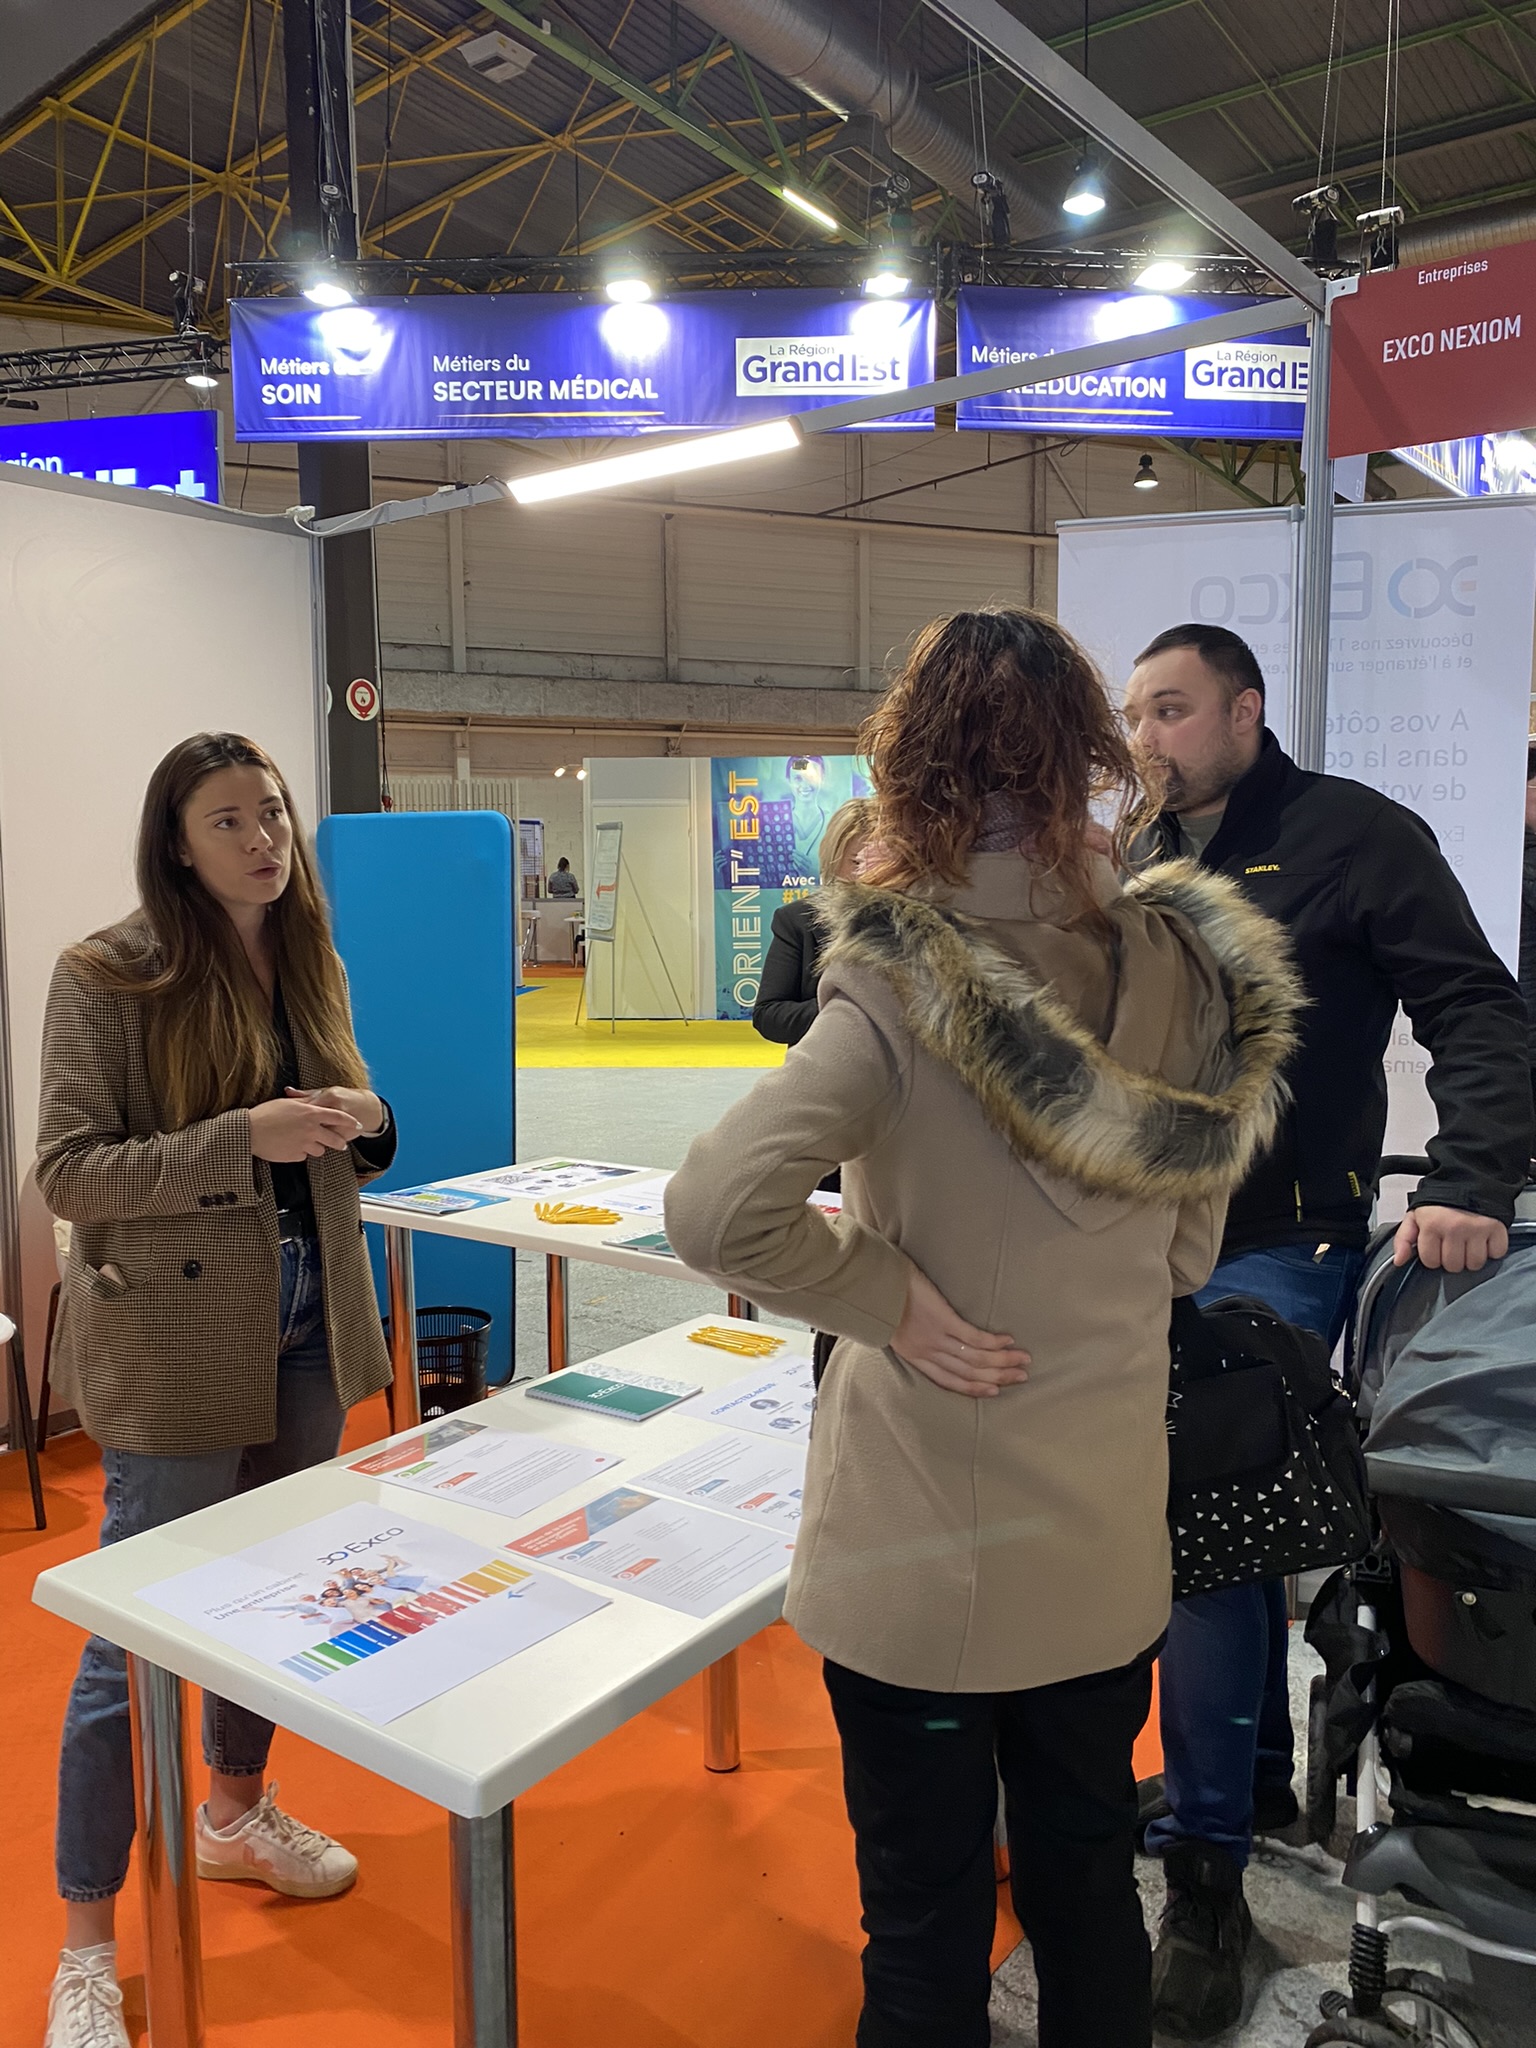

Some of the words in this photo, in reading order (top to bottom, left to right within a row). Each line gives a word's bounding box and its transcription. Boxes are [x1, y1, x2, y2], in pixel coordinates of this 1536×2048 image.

[1418, 260, 1488, 285] Entreprises
[1383, 332, 1434, 363] EXCO
[1440, 314, 1521, 352] NEXIOM
[769, 345, 785, 356] La
[789, 343, 835, 357] Région
[1217, 350, 1231, 361] La
[1235, 350, 1278, 363] Région
[261, 357, 330, 375] Métiers
[433, 355, 501, 372] Métiers
[505, 354, 530, 371] du
[1191, 360, 1286, 389] Grand
[261, 383, 321, 405] SOIN
[433, 380, 543, 402] SECTEUR
[549, 374, 658, 400] MÉDICAL
[1244, 864, 1280, 874] STANLEY
[782, 874, 816, 886] Avec
